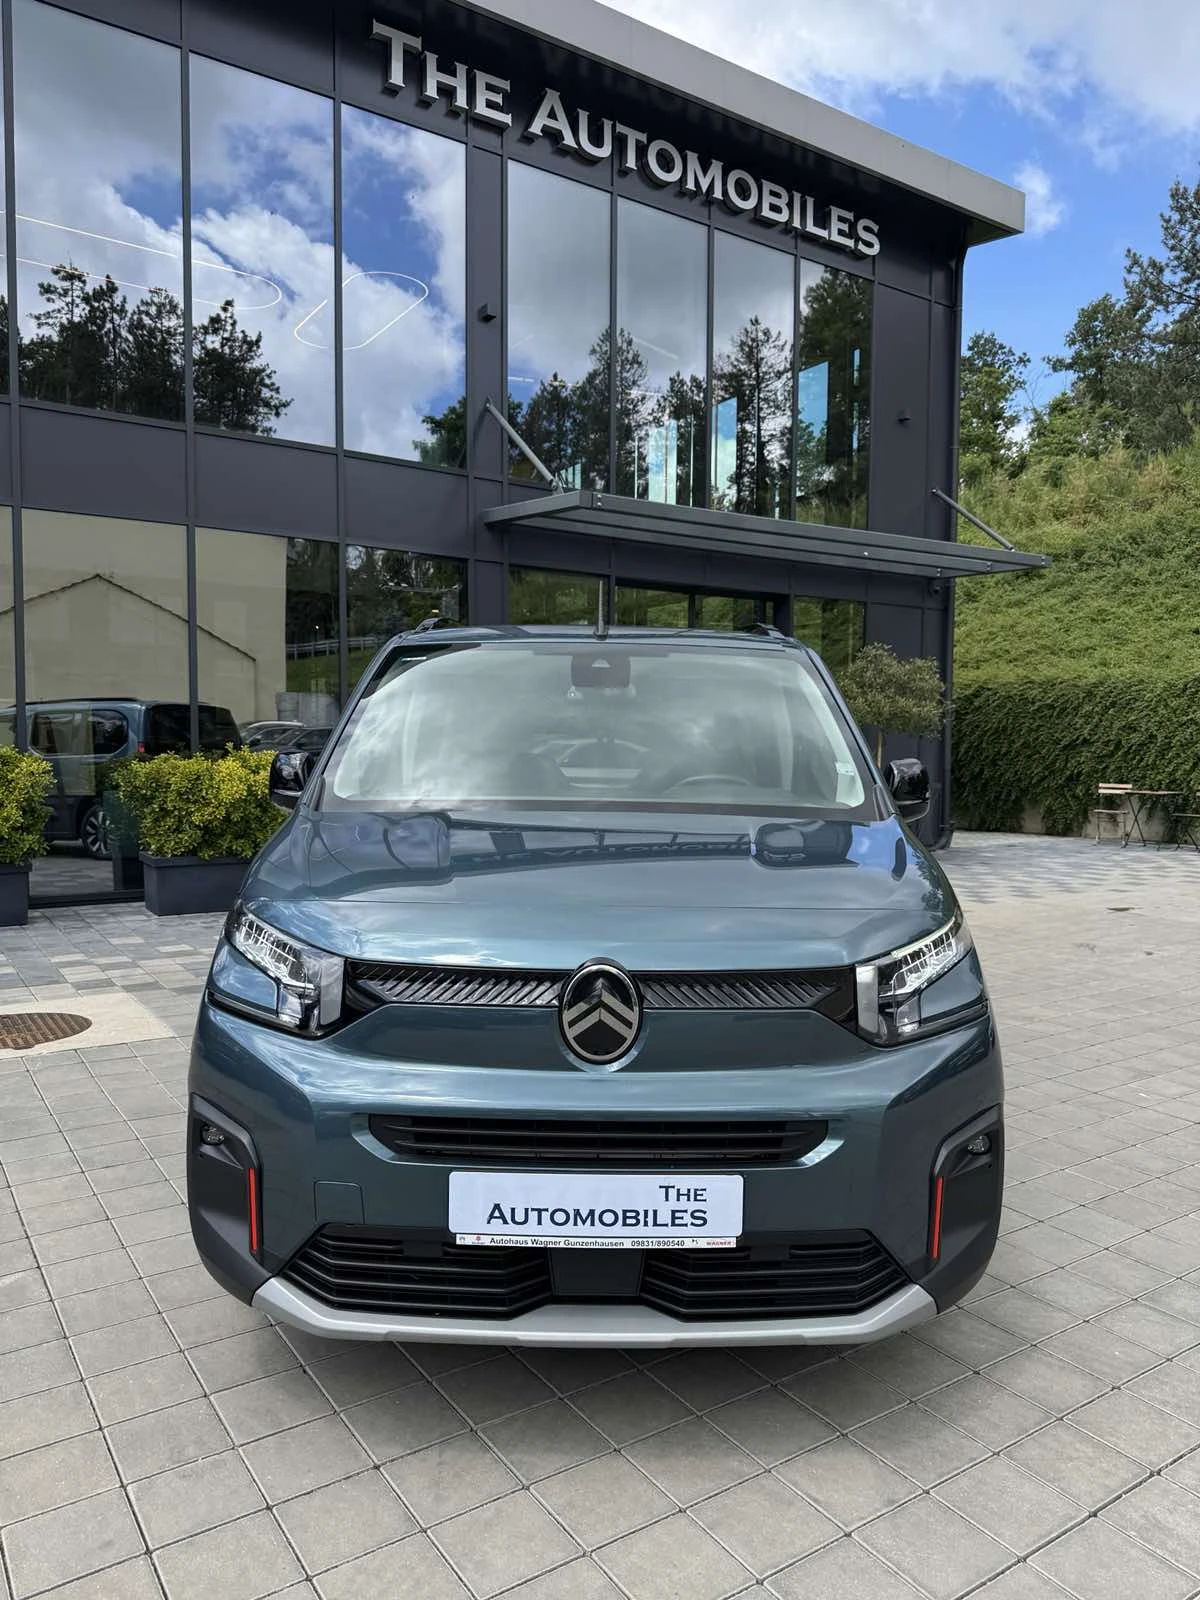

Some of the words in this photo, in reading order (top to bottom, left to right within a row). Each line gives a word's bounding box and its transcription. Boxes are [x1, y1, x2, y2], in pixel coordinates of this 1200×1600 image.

[370, 18, 512, 127] THE
[527, 87, 881, 256] AUTOMOBILES
[659, 1185, 707, 1202] THE
[487, 1203, 708, 1227] AUTOMOBILES
[489, 1237, 529, 1245] Autohaus
[530, 1239, 561, 1248] Wagner
[631, 1240, 685, 1248] 09831/890540
